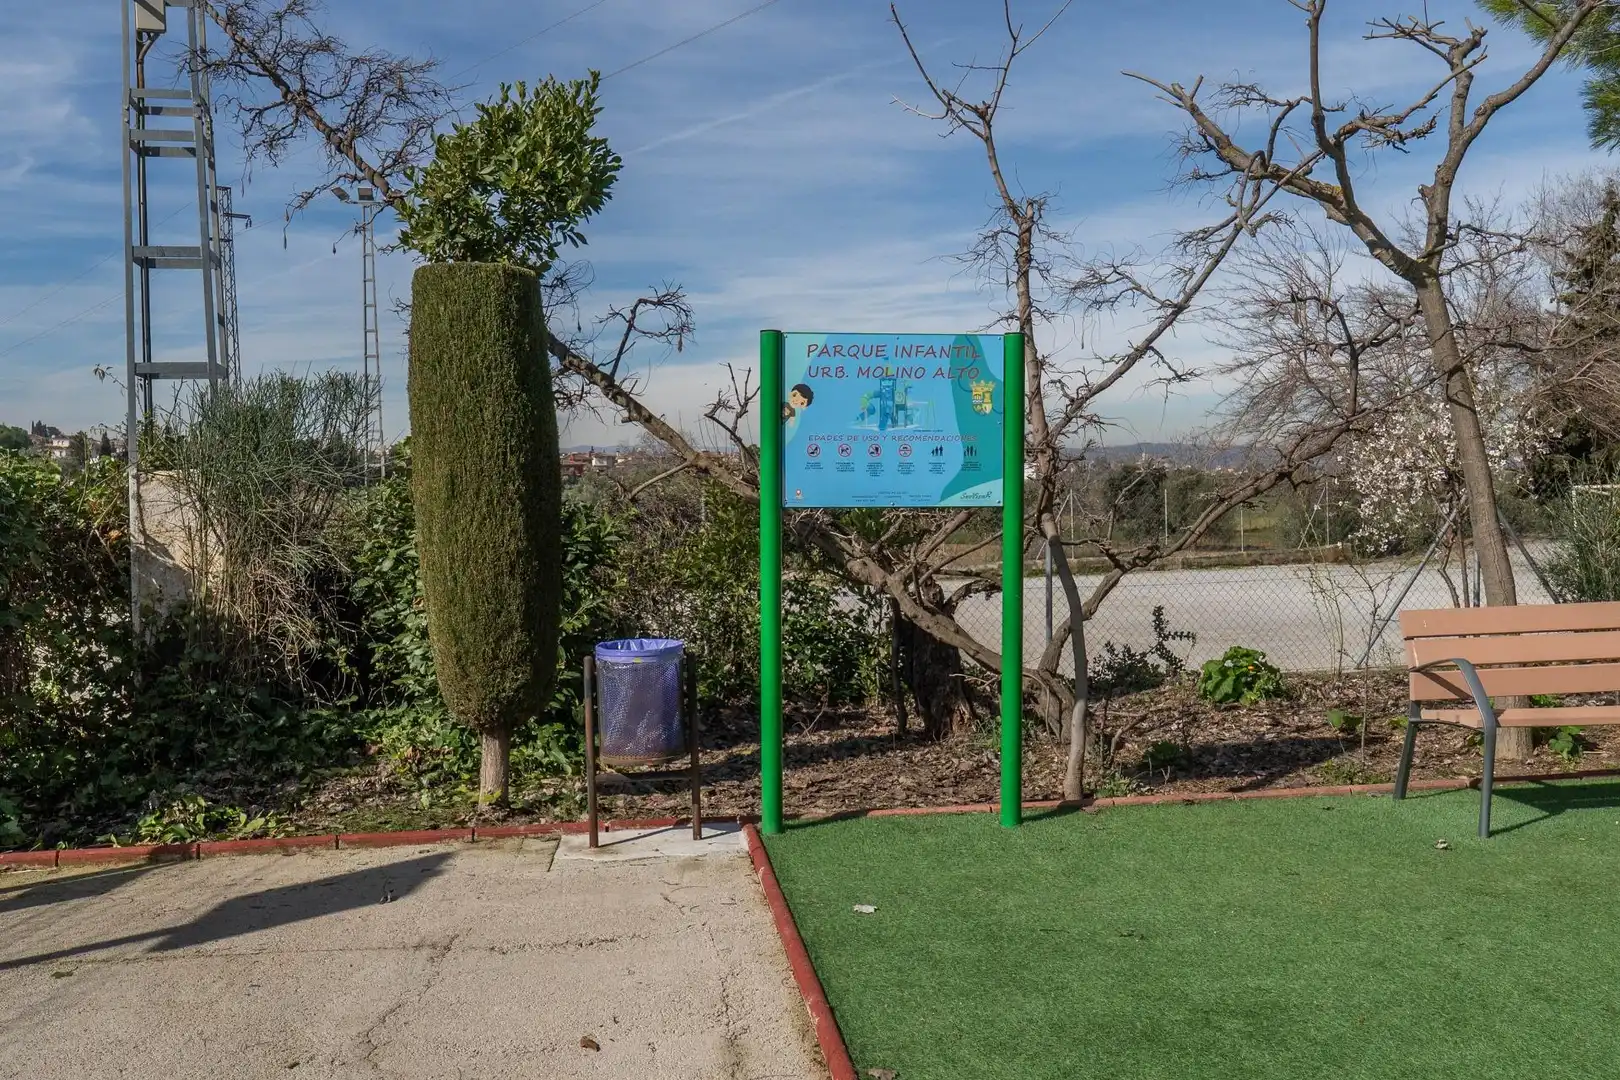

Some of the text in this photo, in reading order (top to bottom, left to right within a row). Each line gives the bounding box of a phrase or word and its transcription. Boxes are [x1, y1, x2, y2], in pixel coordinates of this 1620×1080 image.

[807, 343, 981, 359] PARQUE INFANTIL
[808, 365, 980, 379] URB. MOLINO ALTO
[891, 434, 978, 442] RECOMENDACIONES
